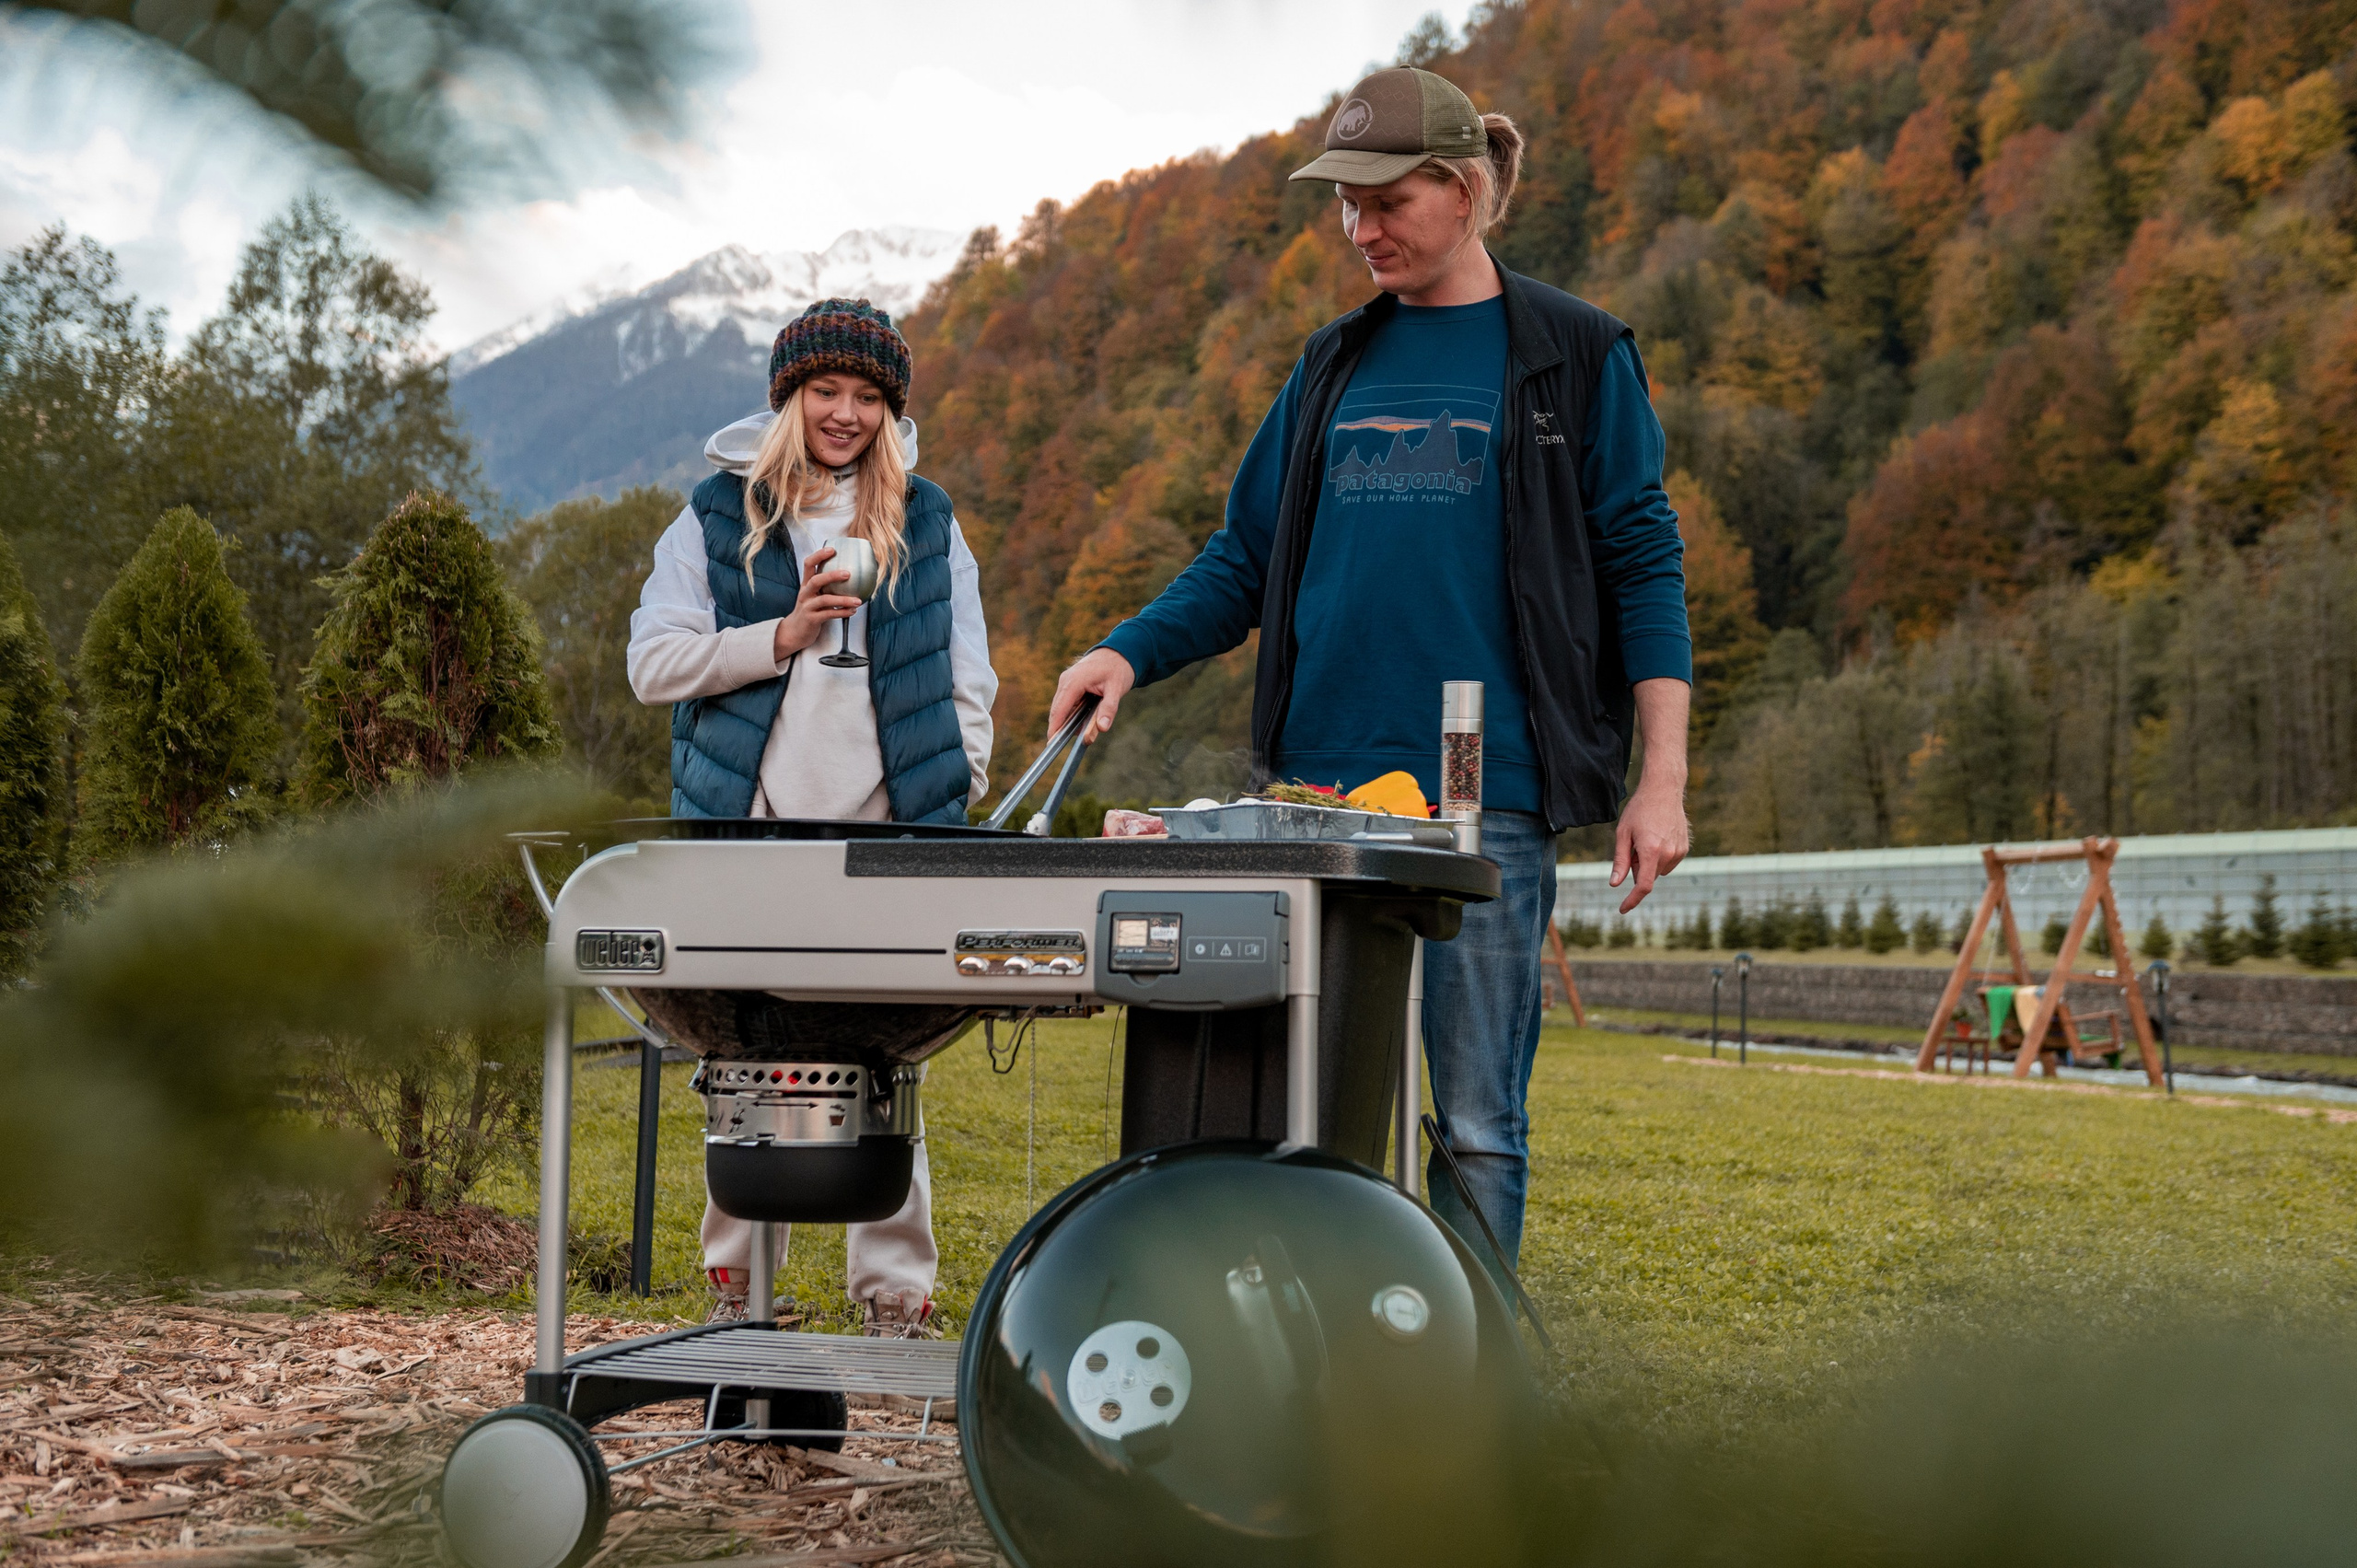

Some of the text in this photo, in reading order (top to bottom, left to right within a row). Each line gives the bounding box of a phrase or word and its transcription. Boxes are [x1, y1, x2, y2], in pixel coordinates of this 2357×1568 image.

[1335, 469, 1472, 497] patagonia
[1341, 494, 1457, 505] SAVE OUR HOME PLANET
[581, 931, 642, 967] weber
